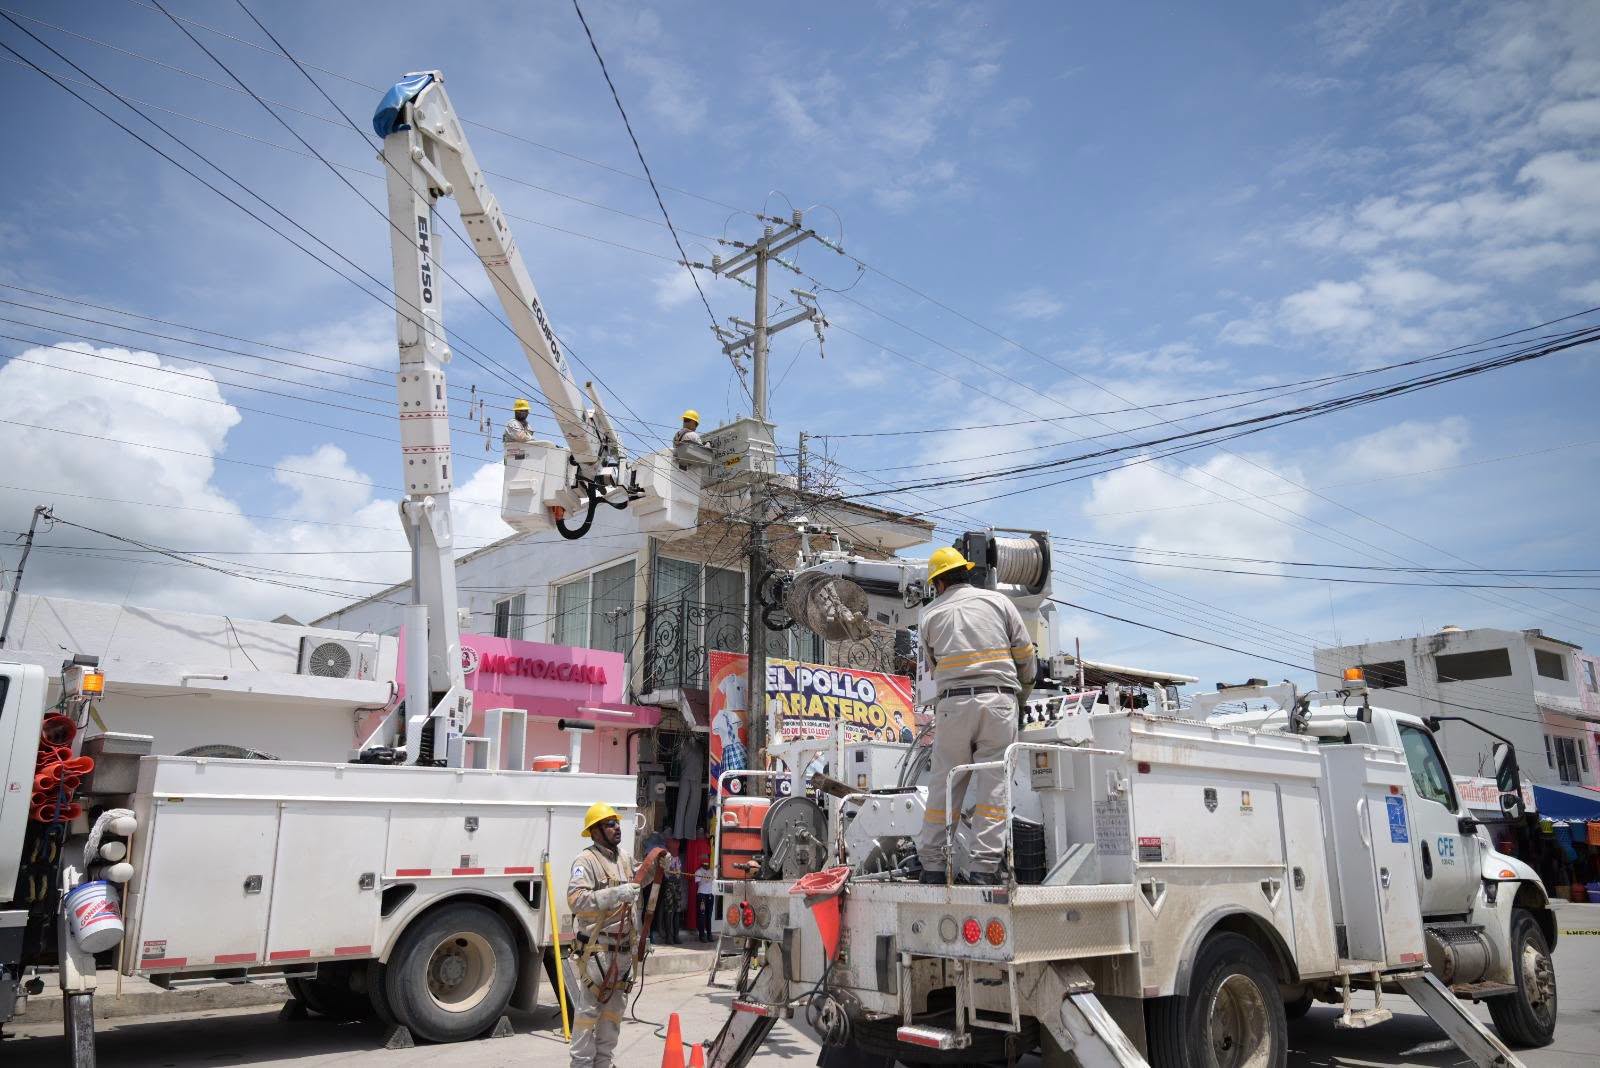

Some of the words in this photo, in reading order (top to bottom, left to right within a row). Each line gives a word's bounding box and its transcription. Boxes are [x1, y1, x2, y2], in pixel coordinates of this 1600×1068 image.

[417, 215, 432, 304] EH-150
[532, 297, 561, 363] EQUIPOS
[478, 652, 608, 685] MICHOACANA
[766, 666, 793, 691] EL
[796, 667, 876, 703] POLLO
[766, 692, 886, 729] ARATERO
[1437, 836, 1455, 857] CFE
